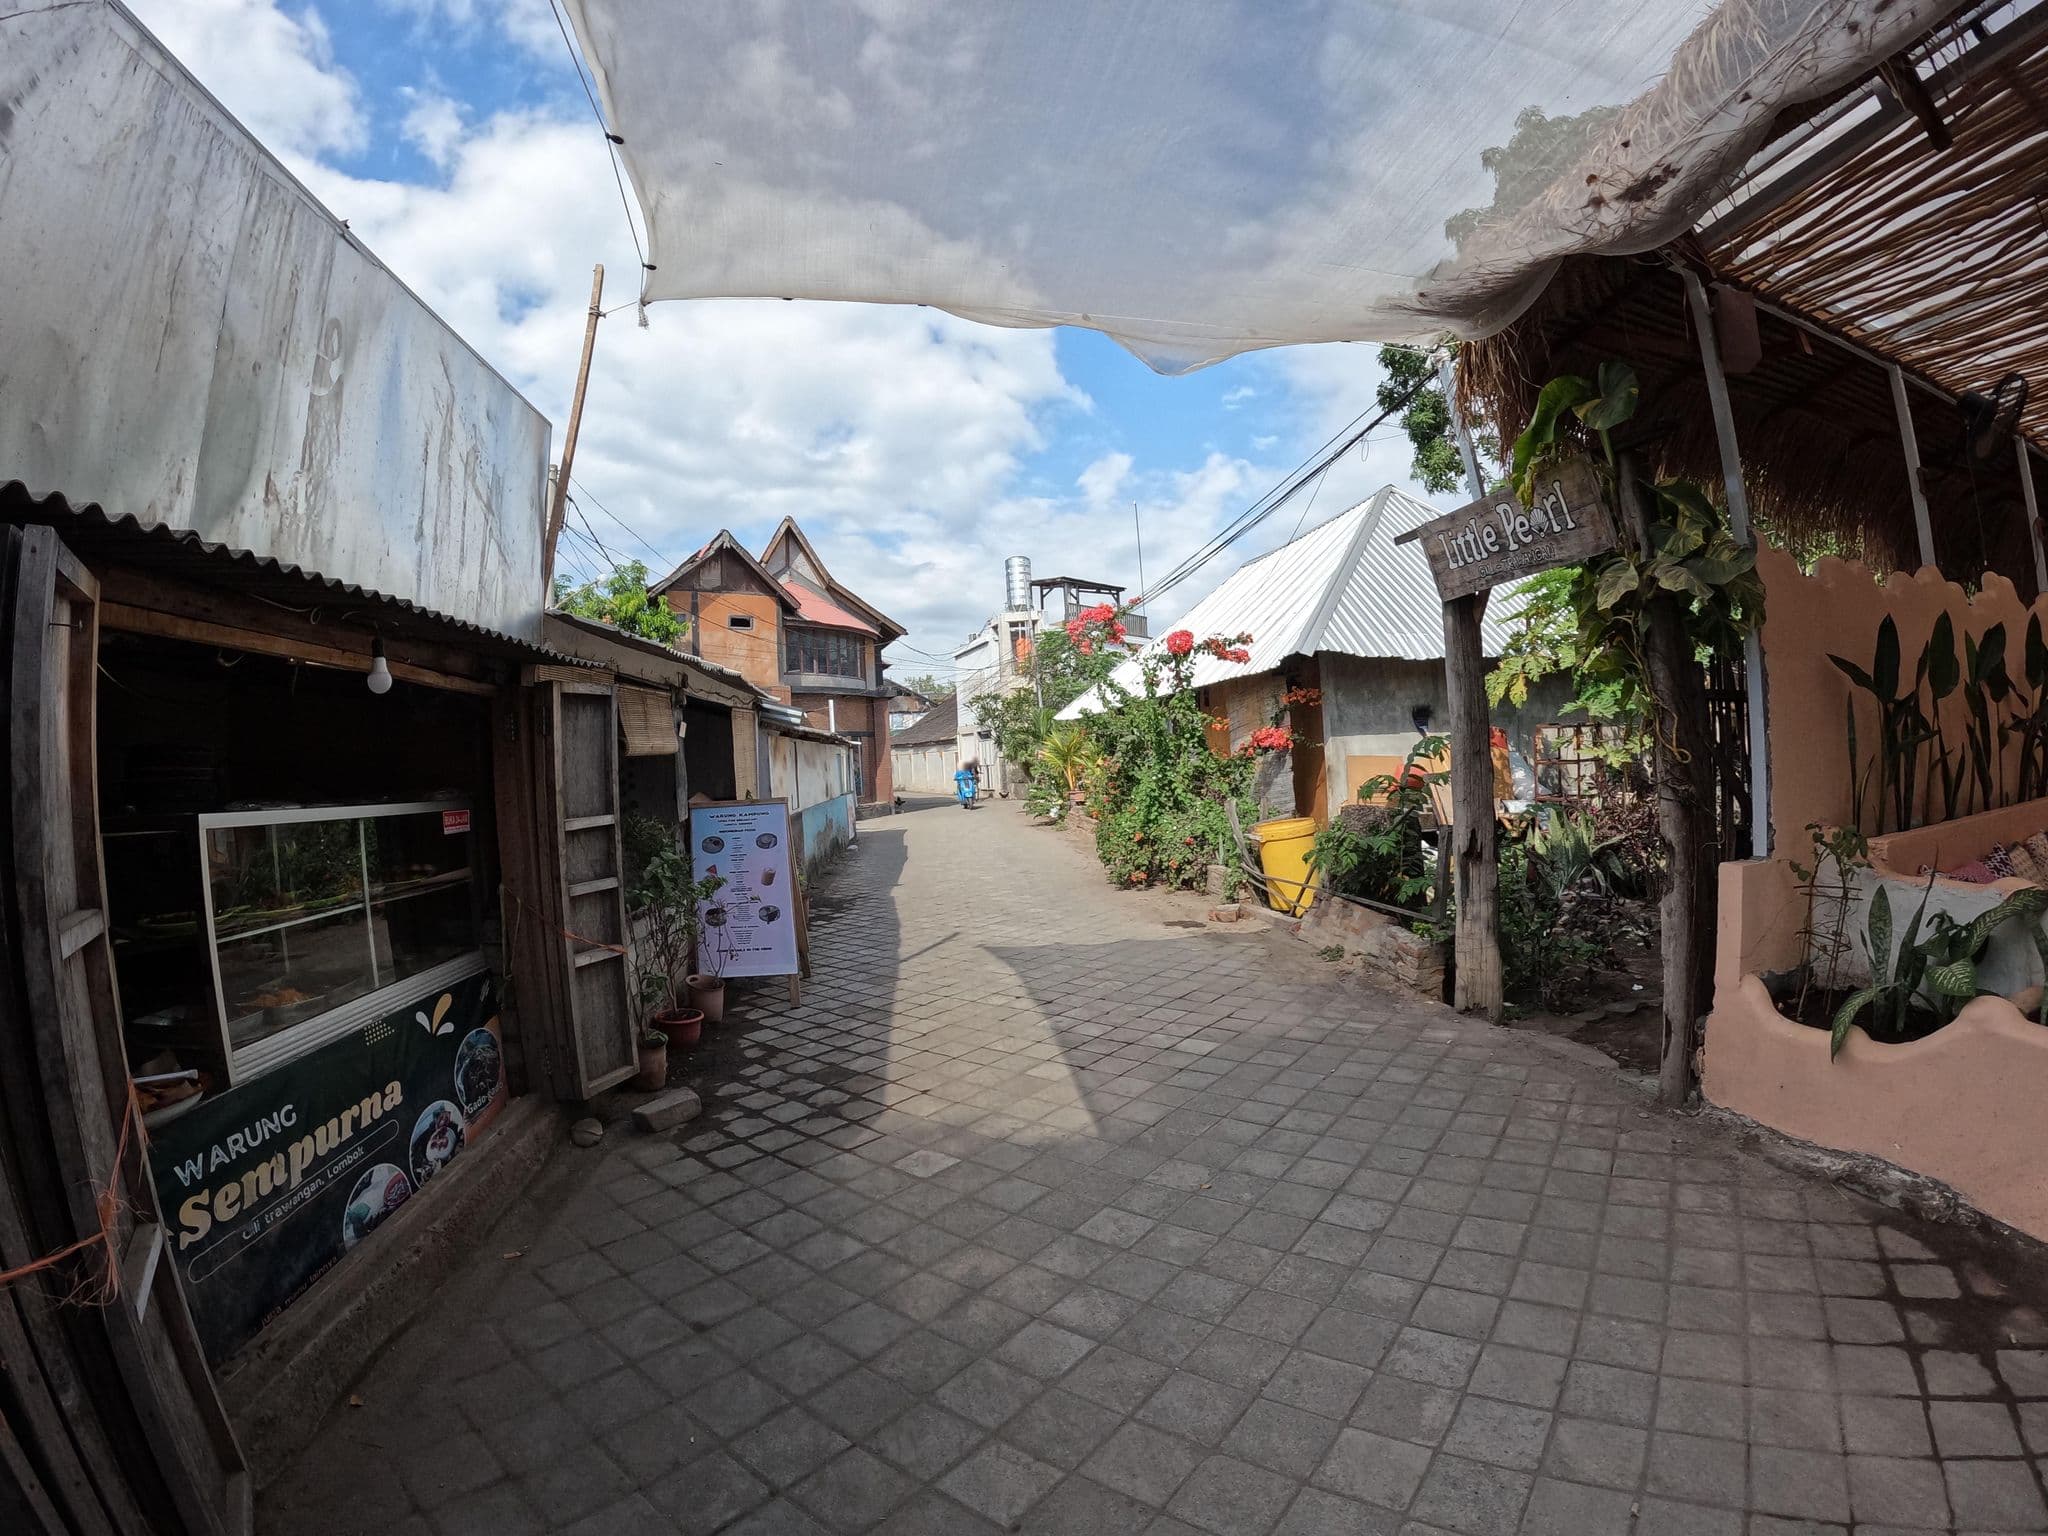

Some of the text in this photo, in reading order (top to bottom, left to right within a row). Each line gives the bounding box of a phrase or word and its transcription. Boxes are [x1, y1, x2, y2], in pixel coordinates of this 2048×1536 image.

[1438, 518, 1499, 569] Little
[173, 1104, 297, 1187] WARUNG
[179, 1080, 403, 1250] Sempurna
[264, 1180, 325, 1223] trawangan,
[327, 1145, 364, 1178] Lombok
